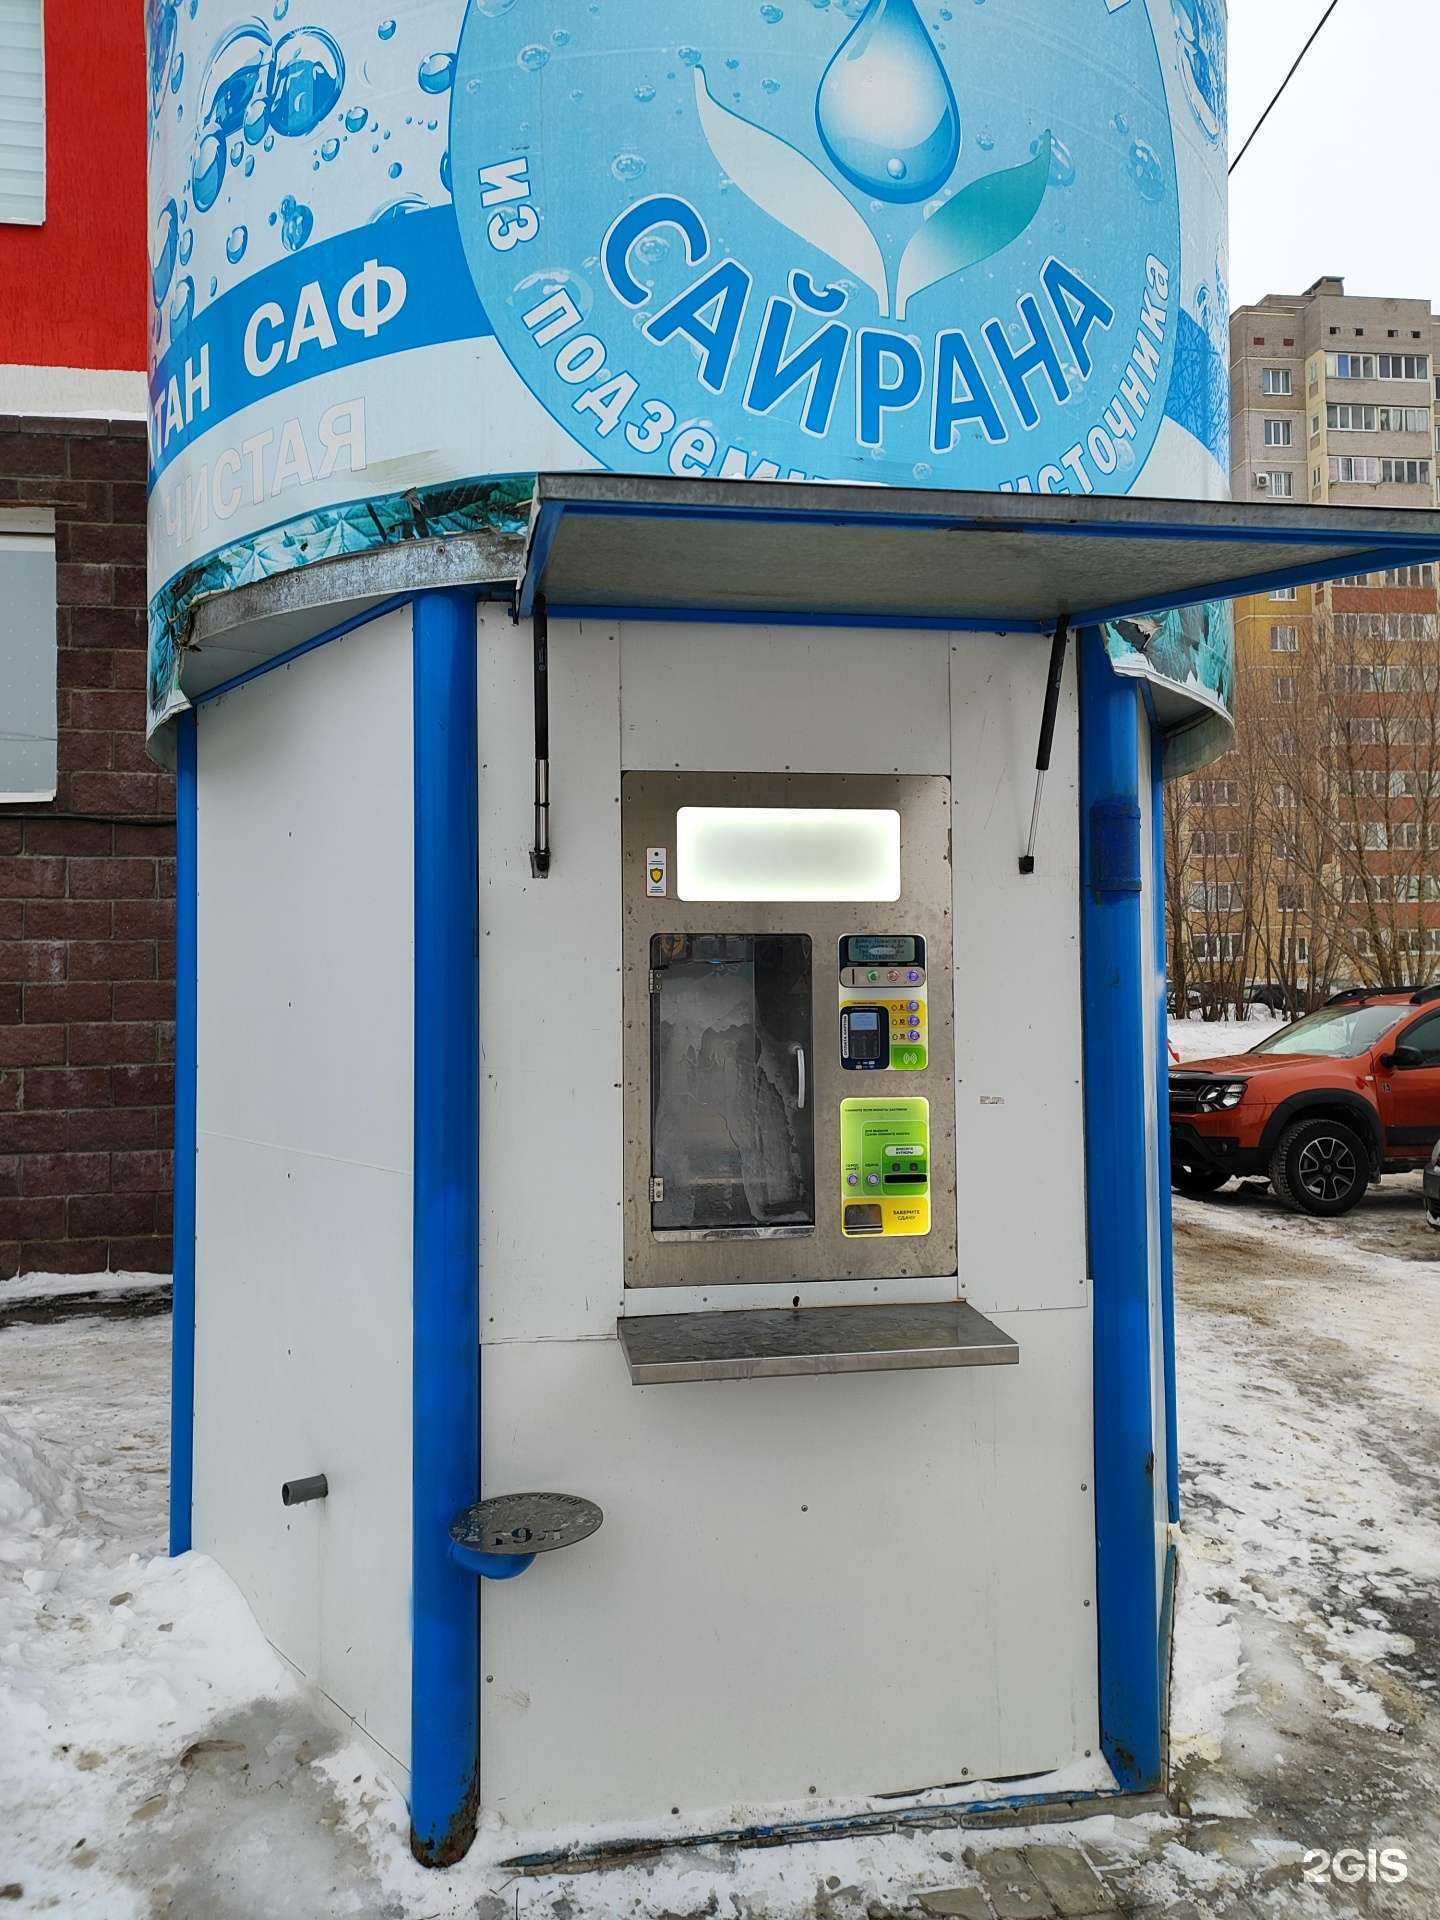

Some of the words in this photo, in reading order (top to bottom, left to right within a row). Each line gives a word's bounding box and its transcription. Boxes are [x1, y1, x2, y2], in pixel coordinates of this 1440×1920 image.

[243, 259, 407, 377] САФ
[601, 193, 1114, 454] САЙРАНА
[164, 397, 368, 549] ЧИСТАЯ
